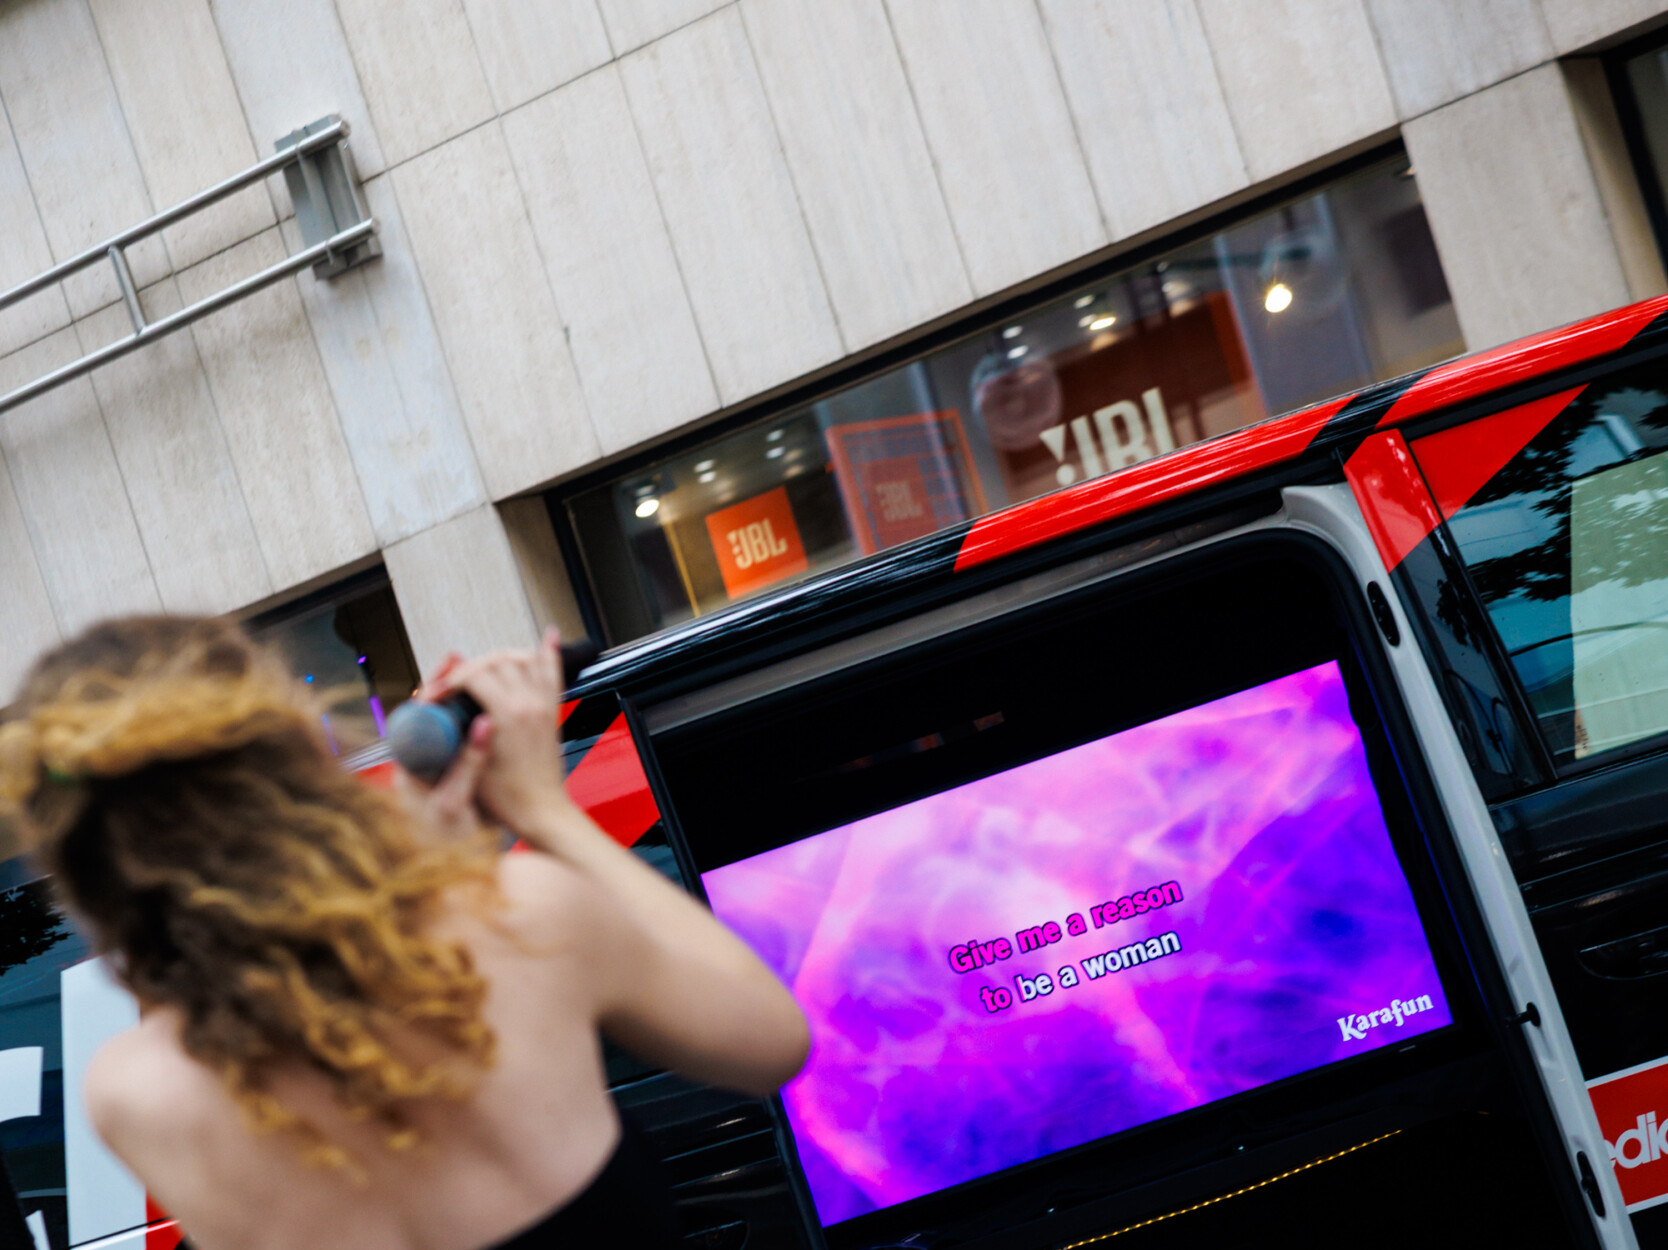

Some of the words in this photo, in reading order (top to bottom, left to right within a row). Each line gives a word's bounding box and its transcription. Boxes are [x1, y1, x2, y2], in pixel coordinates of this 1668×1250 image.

[726, 517, 788, 570] JBL
[949, 938, 1013, 974] Give
[1015, 921, 1063, 954] me
[1066, 912, 1088, 937] a
[1090, 880, 1184, 929] reason
[980, 986, 1013, 1014] to
[1014, 974, 1055, 1003] be
[1057, 964, 1080, 989] a
[1080, 931, 1183, 981] woman
[1336, 994, 1434, 1042] Karafun
